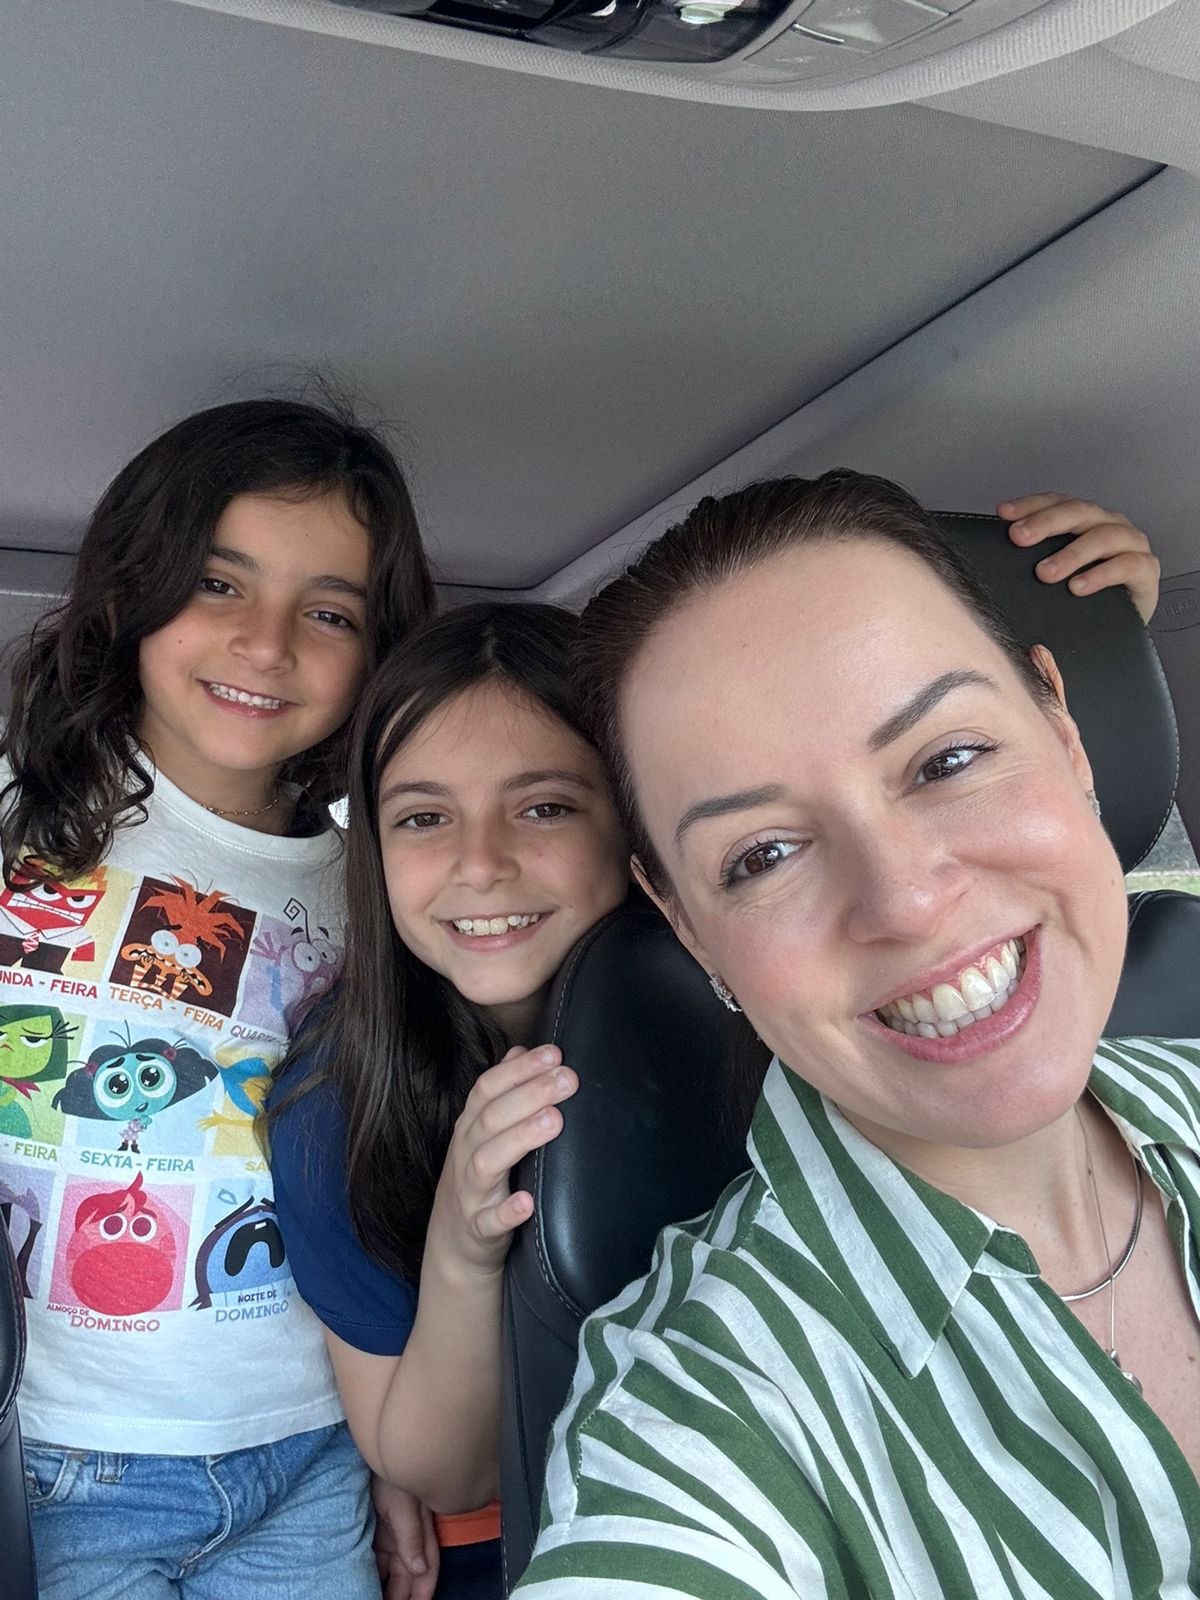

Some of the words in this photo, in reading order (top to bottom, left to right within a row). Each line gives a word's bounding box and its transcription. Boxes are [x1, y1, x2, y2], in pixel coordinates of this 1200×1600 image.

[0, 970, 34, 987] NDA
[50, 978, 98, 999] FEIRA
[109, 986, 164, 1010] TERÇA
[183, 1006, 225, 1031] FEIRA
[14, 1141, 58, 1162] FEIRA
[237, 1291, 265, 1303] NOITE
[266, 1289, 278, 1299] DE
[46, 1303, 78, 1315] ALMOÇO
[79, 1309, 90, 1317] DE
[215, 1299, 289, 1323] DOMINGO
[70, 1315, 161, 1333] DOMINGO
